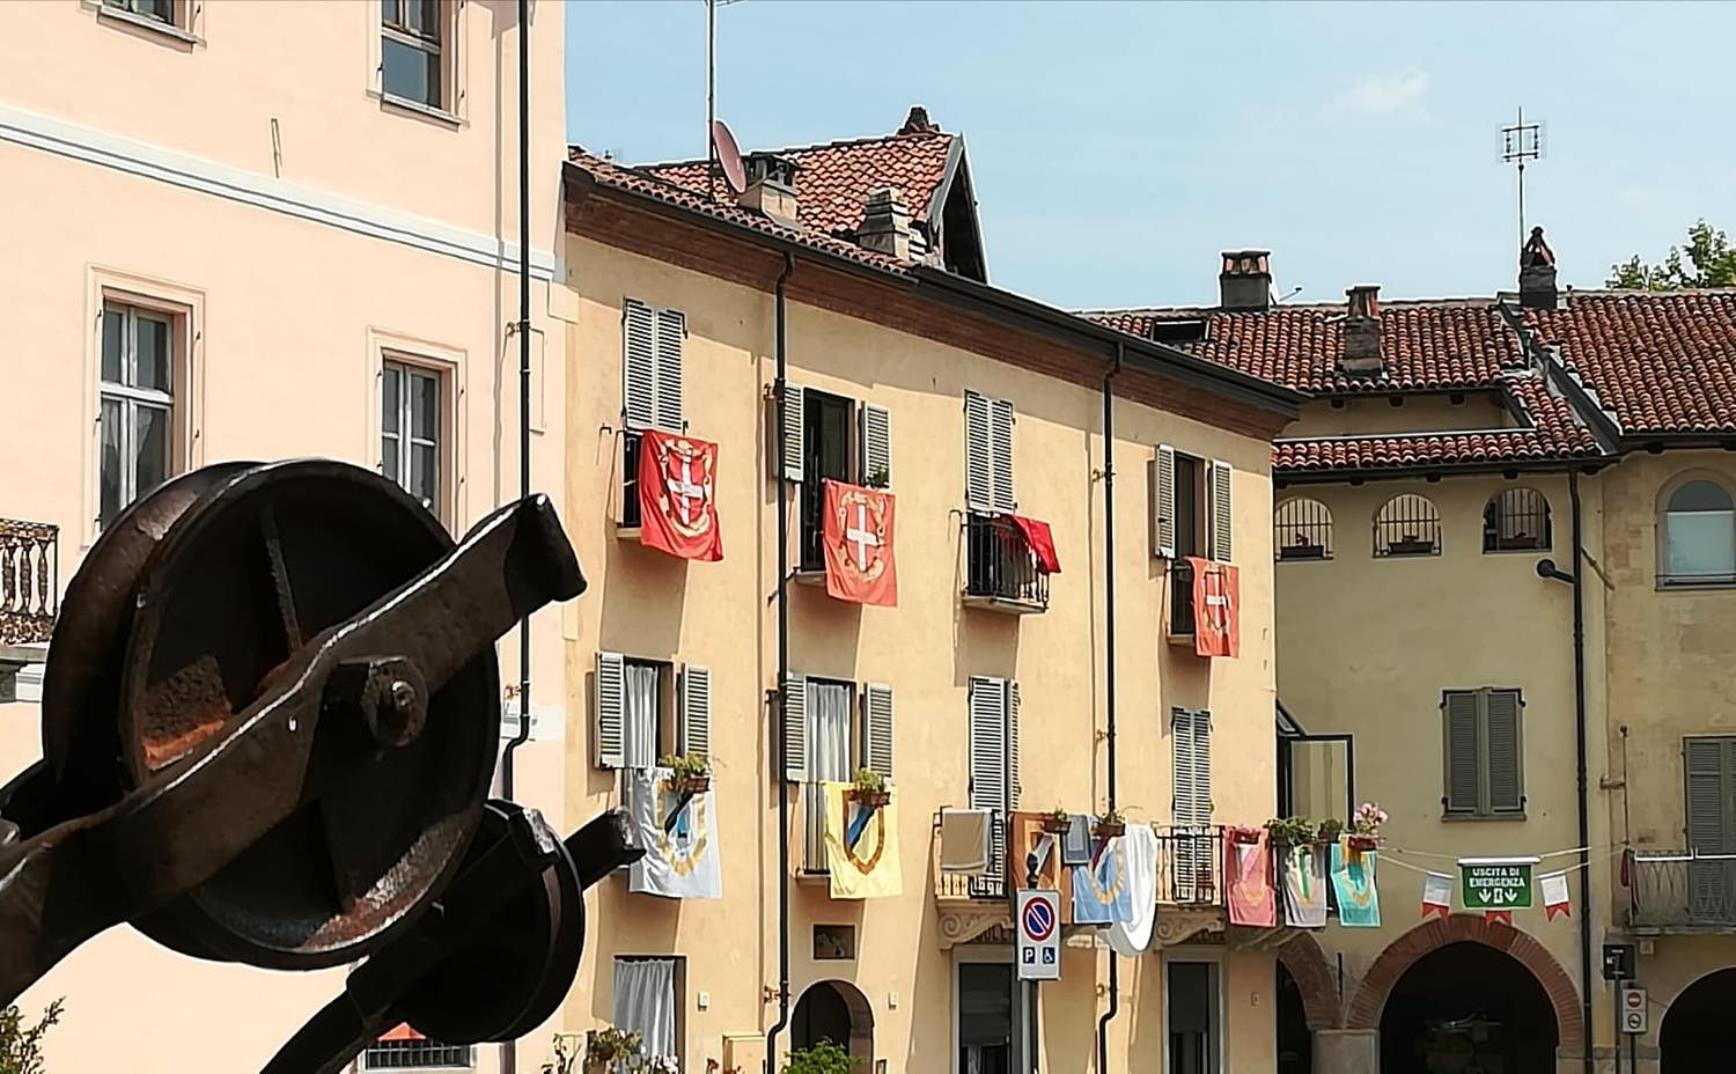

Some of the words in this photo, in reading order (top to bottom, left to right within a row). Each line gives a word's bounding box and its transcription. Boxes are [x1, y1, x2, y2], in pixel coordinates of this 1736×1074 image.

[1472, 868, 1508, 876] USCITA
[1509, 868, 1520, 876] DI
[1469, 877, 1525, 887] EMERGENZA
[1025, 949, 1033, 962] P
